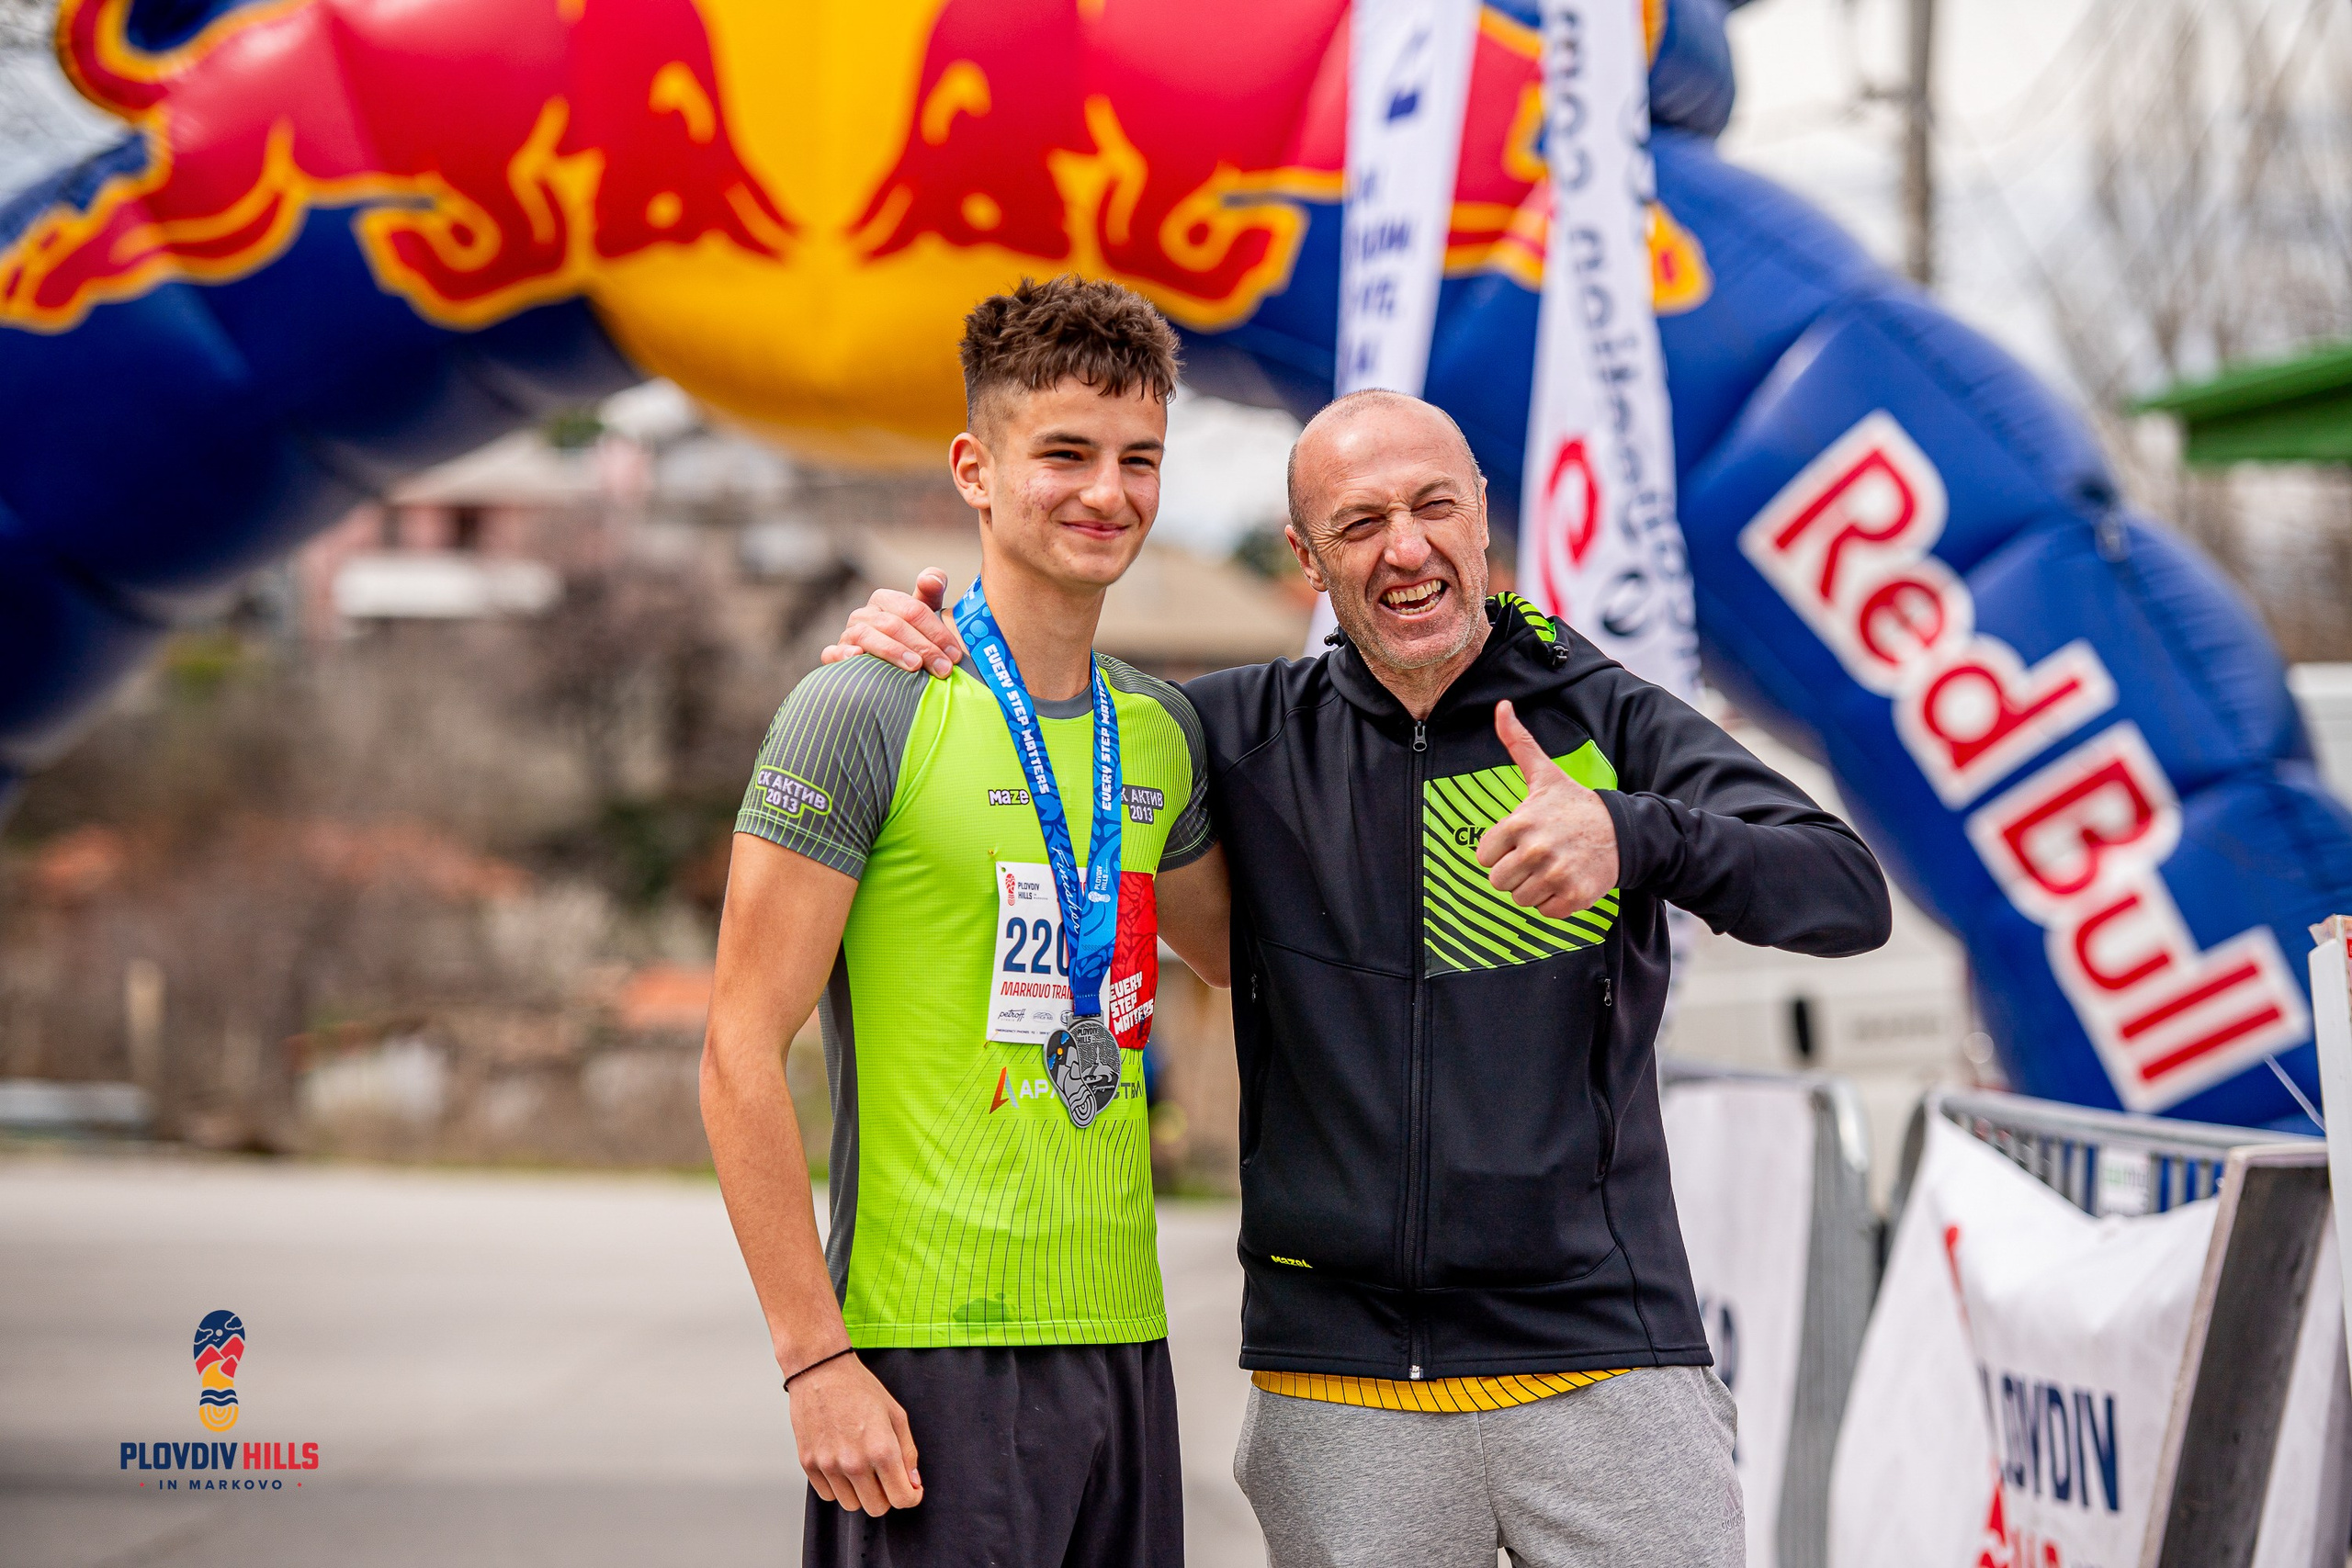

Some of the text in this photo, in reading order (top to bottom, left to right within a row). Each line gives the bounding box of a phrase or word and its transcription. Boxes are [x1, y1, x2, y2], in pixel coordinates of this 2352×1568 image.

[983, 643, 1051, 795] EVERY STEP MATTERS
[1101, 727, 1112, 763] STEP
[1766, 436, 2292, 1093] Red Bull
[765, 788, 799, 813] 2013
[772, 774, 827, 810] АКТИВ
[1102, 765, 1113, 811] EVERY
[1131, 789, 1164, 807] АКТИВ
[1130, 806, 1154, 822] 2013
[1017, 882, 1040, 891] PLOVDIV
[1094, 865, 1102, 891] PLOVDIV
[1101, 873, 1109, 891] HILLS
[1017, 891, 1033, 900] HILLS
[1000, 981, 1051, 998] MARKOVO
[1110, 971, 1143, 1002] EVERY
[998, 1009, 1026, 1022] petroff
[1110, 992, 1137, 1019] STEP
[1113, 998, 1154, 1035] MATTERS
